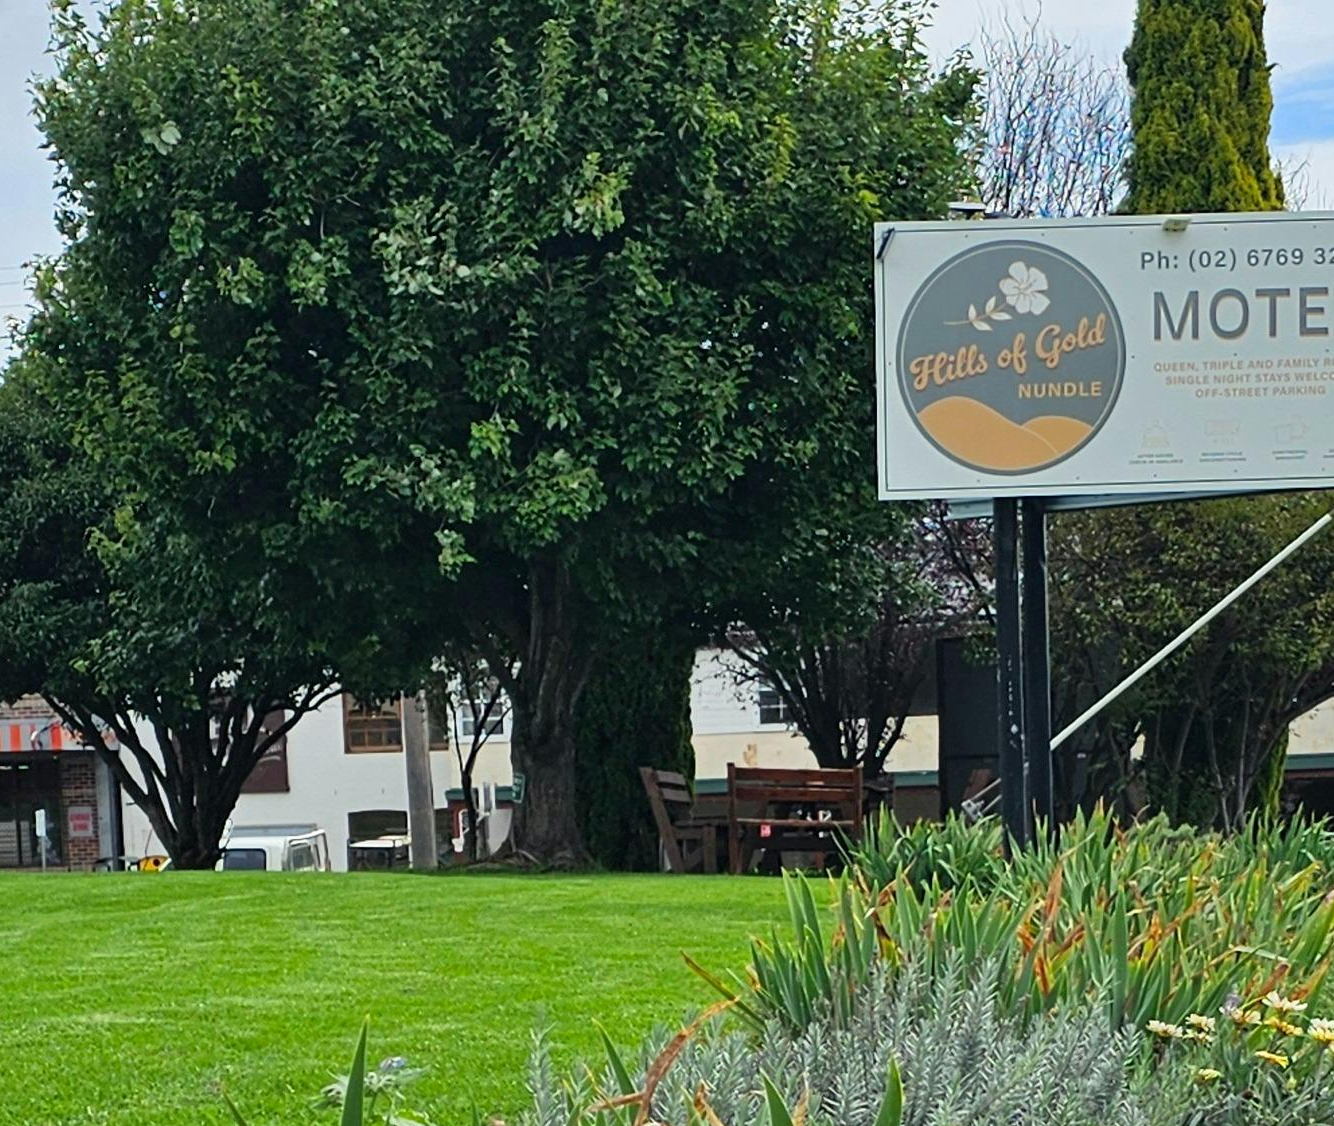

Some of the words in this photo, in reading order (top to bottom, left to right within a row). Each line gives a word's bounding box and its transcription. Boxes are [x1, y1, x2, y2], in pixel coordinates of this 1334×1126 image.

[1140, 250, 1178, 270] Ph:
[1189, 248, 1237, 273] (02)
[1247, 247, 1304, 267] 6769
[909, 343, 988, 391] Hills
[997, 332, 1028, 375] of
[1035, 312, 1107, 369] Gold
[1153, 362, 1199, 373] QUEEN,
[1203, 361, 1244, 371] TRIPLE
[1247, 360, 1274, 370] AND
[1277, 358, 1320, 369] FAMILY
[1165, 375, 1210, 386] SINGLE
[1213, 373, 1251, 384] NIGHT
[1254, 372, 1291, 383] STAYS
[1018, 381, 1103, 398] NUNDLE
[1195, 387, 1269, 398] OFF-STREET
[1273, 385, 1327, 397] PARKING
